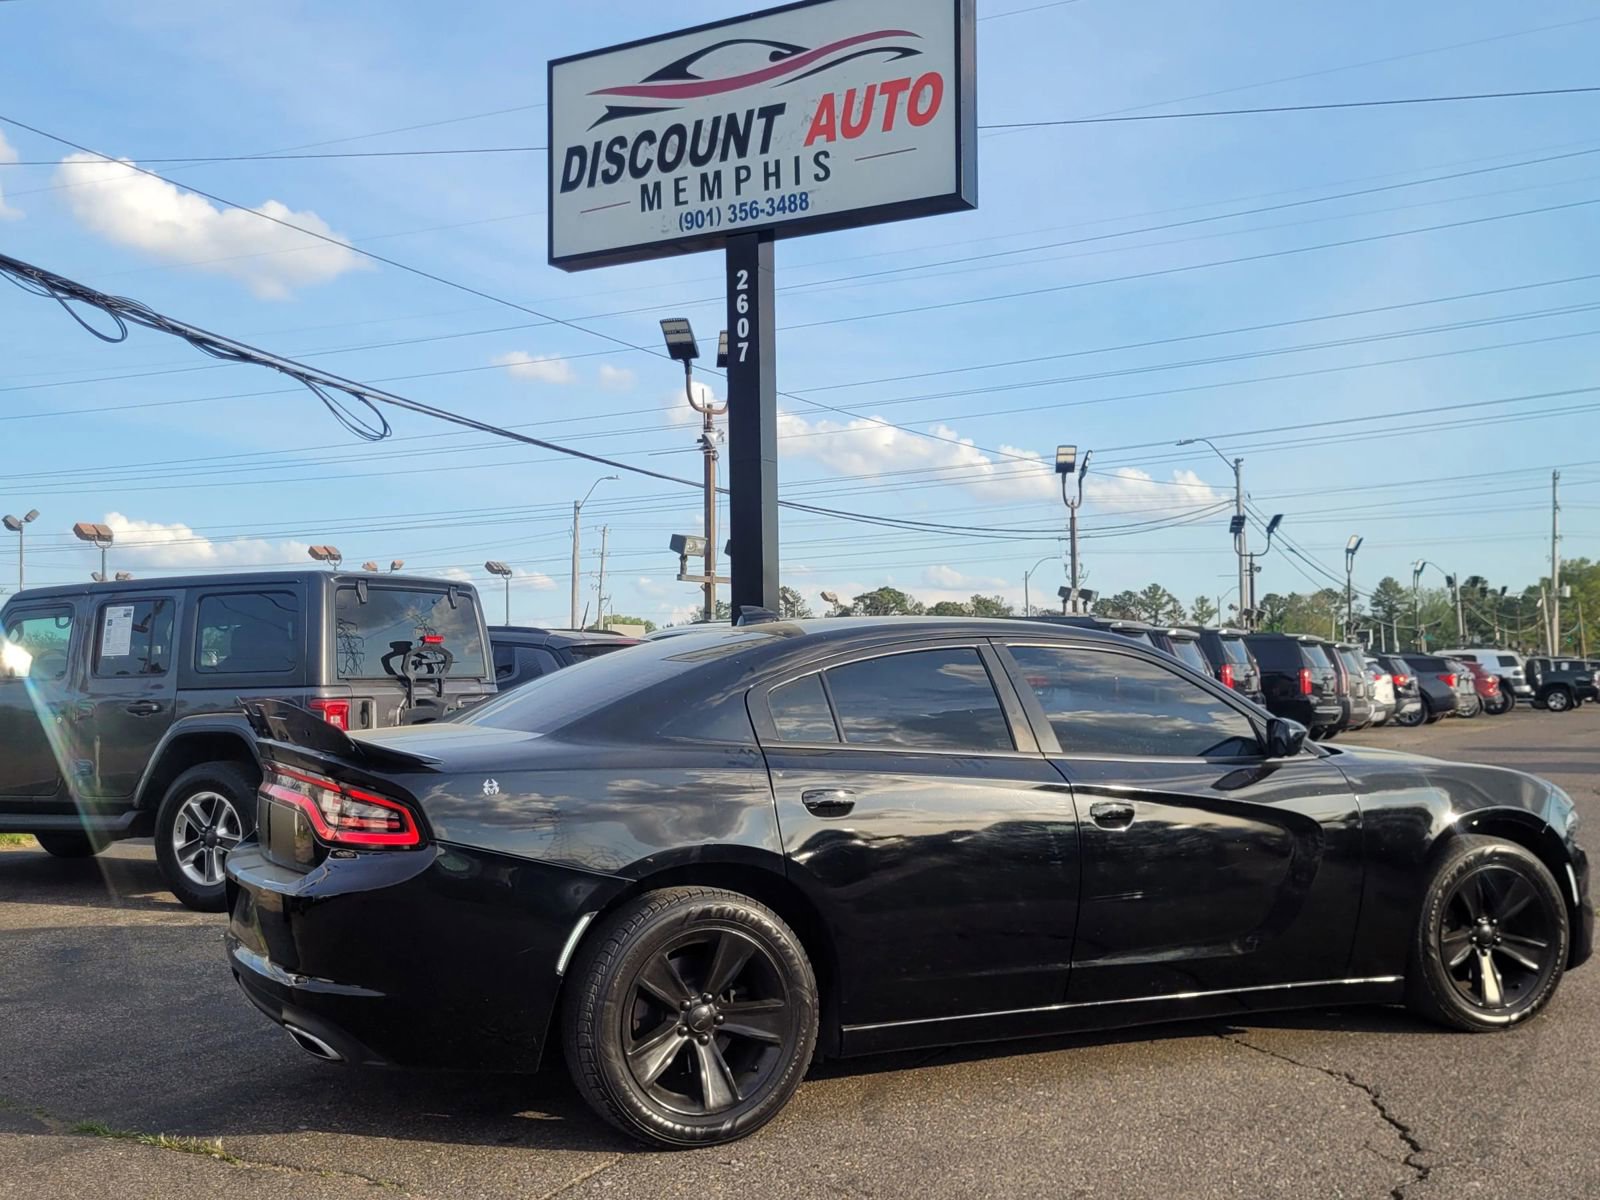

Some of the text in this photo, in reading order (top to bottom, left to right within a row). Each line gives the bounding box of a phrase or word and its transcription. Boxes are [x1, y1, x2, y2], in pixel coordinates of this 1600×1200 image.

[560, 71, 944, 194] DISCOUNT AUTO
[640, 150, 831, 213] MEMPHIS
[678, 191, 810, 232] (901) 356-3488
[736, 269, 750, 362] 2607
